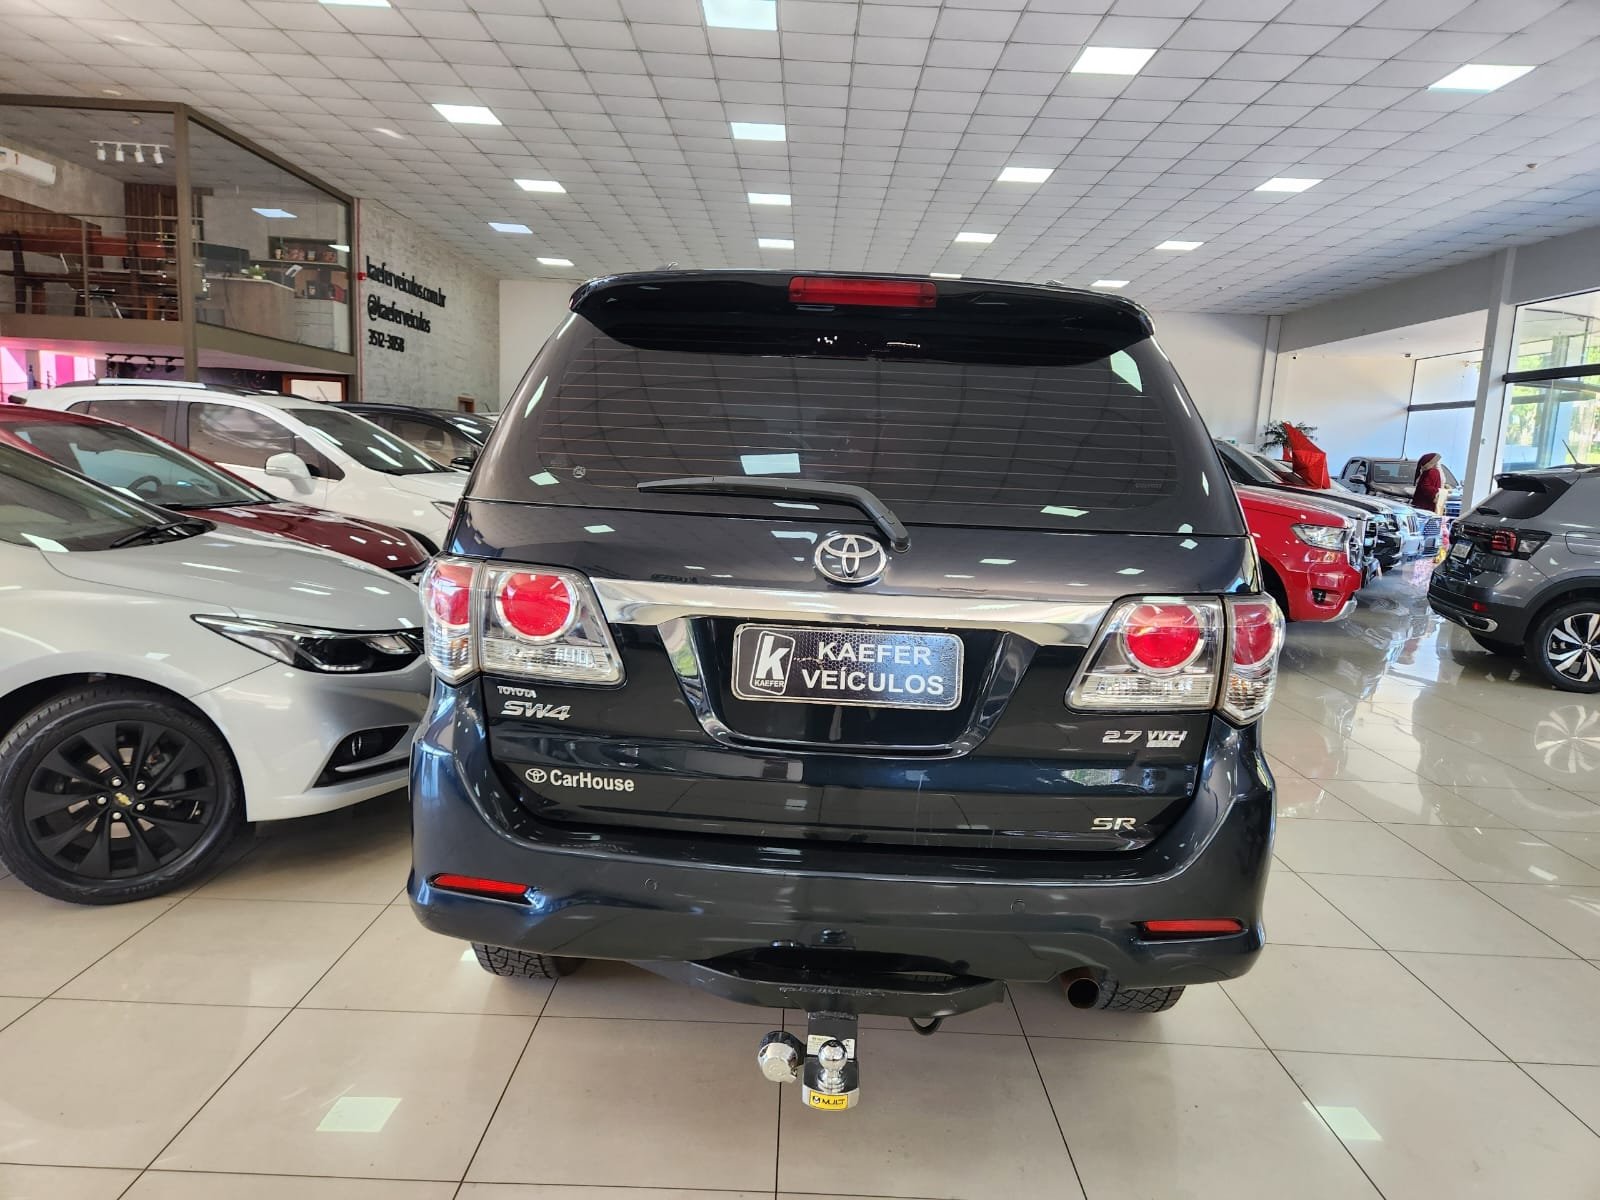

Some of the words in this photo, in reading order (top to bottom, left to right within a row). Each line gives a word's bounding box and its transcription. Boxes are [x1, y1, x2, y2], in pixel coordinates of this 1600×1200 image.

[817, 641, 933, 666] KAEFER
[496, 685, 537, 698] TOYOTA
[753, 678, 786, 689] KAEFER
[801, 667, 945, 696] VEÍCULOS
[500, 700, 572, 721] SW4
[549, 769, 635, 792] CarHouse
[1090, 817, 1137, 831] SR
